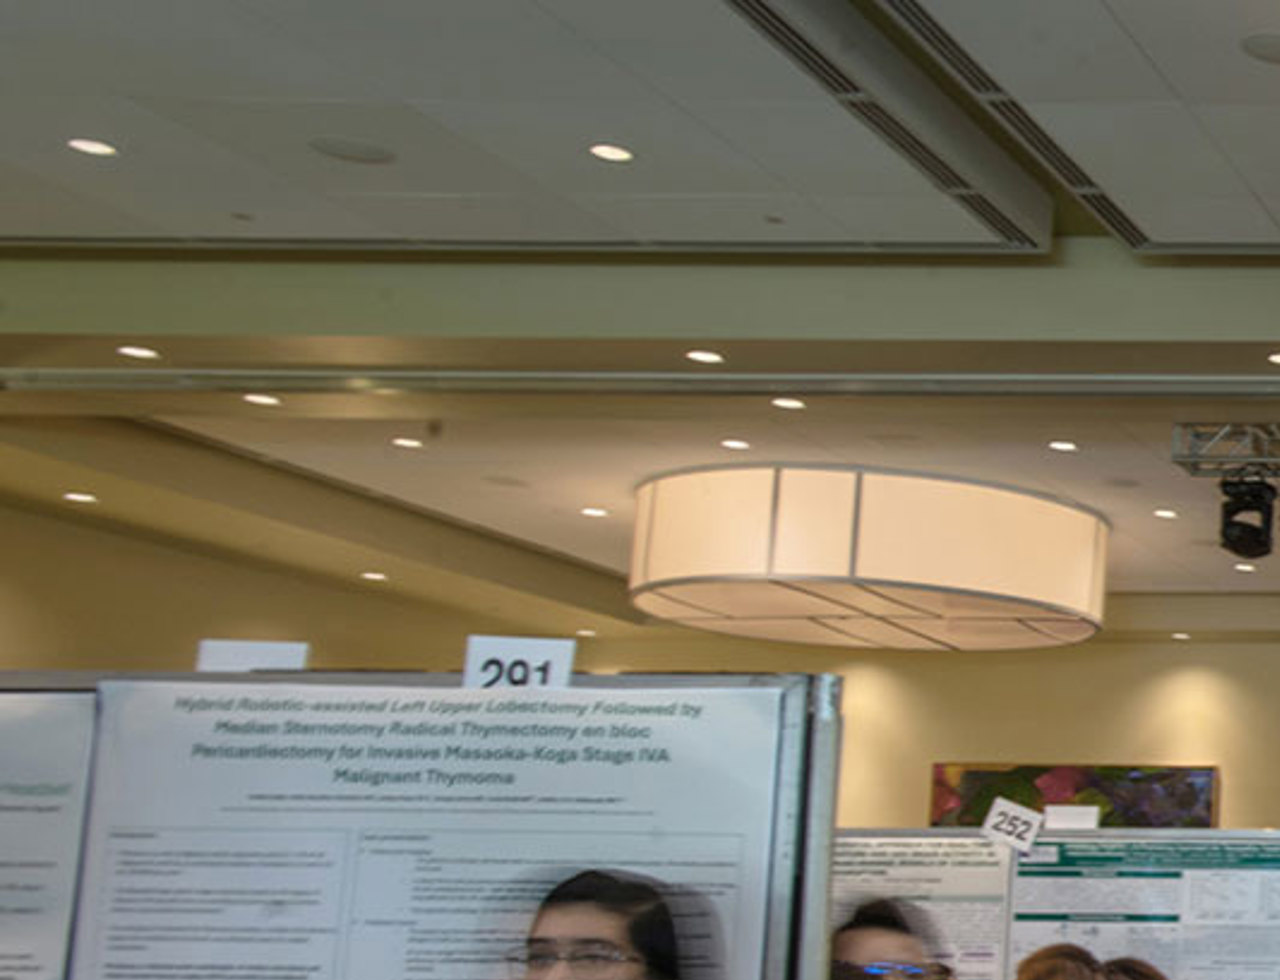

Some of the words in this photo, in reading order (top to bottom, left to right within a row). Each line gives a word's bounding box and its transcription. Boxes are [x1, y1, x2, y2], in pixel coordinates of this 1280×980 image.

[174, 697, 233, 713] Hybrid
[236, 697, 386, 712] Robotic-assisted
[391, 699, 427, 712] Left
[429, 700, 483, 715] Upper
[486, 701, 588, 717] Lobectomy
[592, 702, 677, 716] Followed
[681, 702, 703, 717] by
[214, 721, 279, 735] Median
[283, 721, 385, 738] Sternotomy
[389, 722, 456, 736] Radical
[461, 722, 576, 740] Thymectomy
[582, 726, 605, 738] en
[609, 724, 652, 738] bloc
[191, 743, 336, 763] Pericardiectomy
[340, 744, 362, 758] for
[366, 745, 441, 759] Invasive
[445, 746, 578, 765] Masaoka-Koga
[582, 747, 635, 765] Stage
[638, 748, 672, 763] IVA
[332, 768, 422, 787] Malignant
[427, 769, 516, 788] Thymoma
[991, 811, 1034, 842] 252
